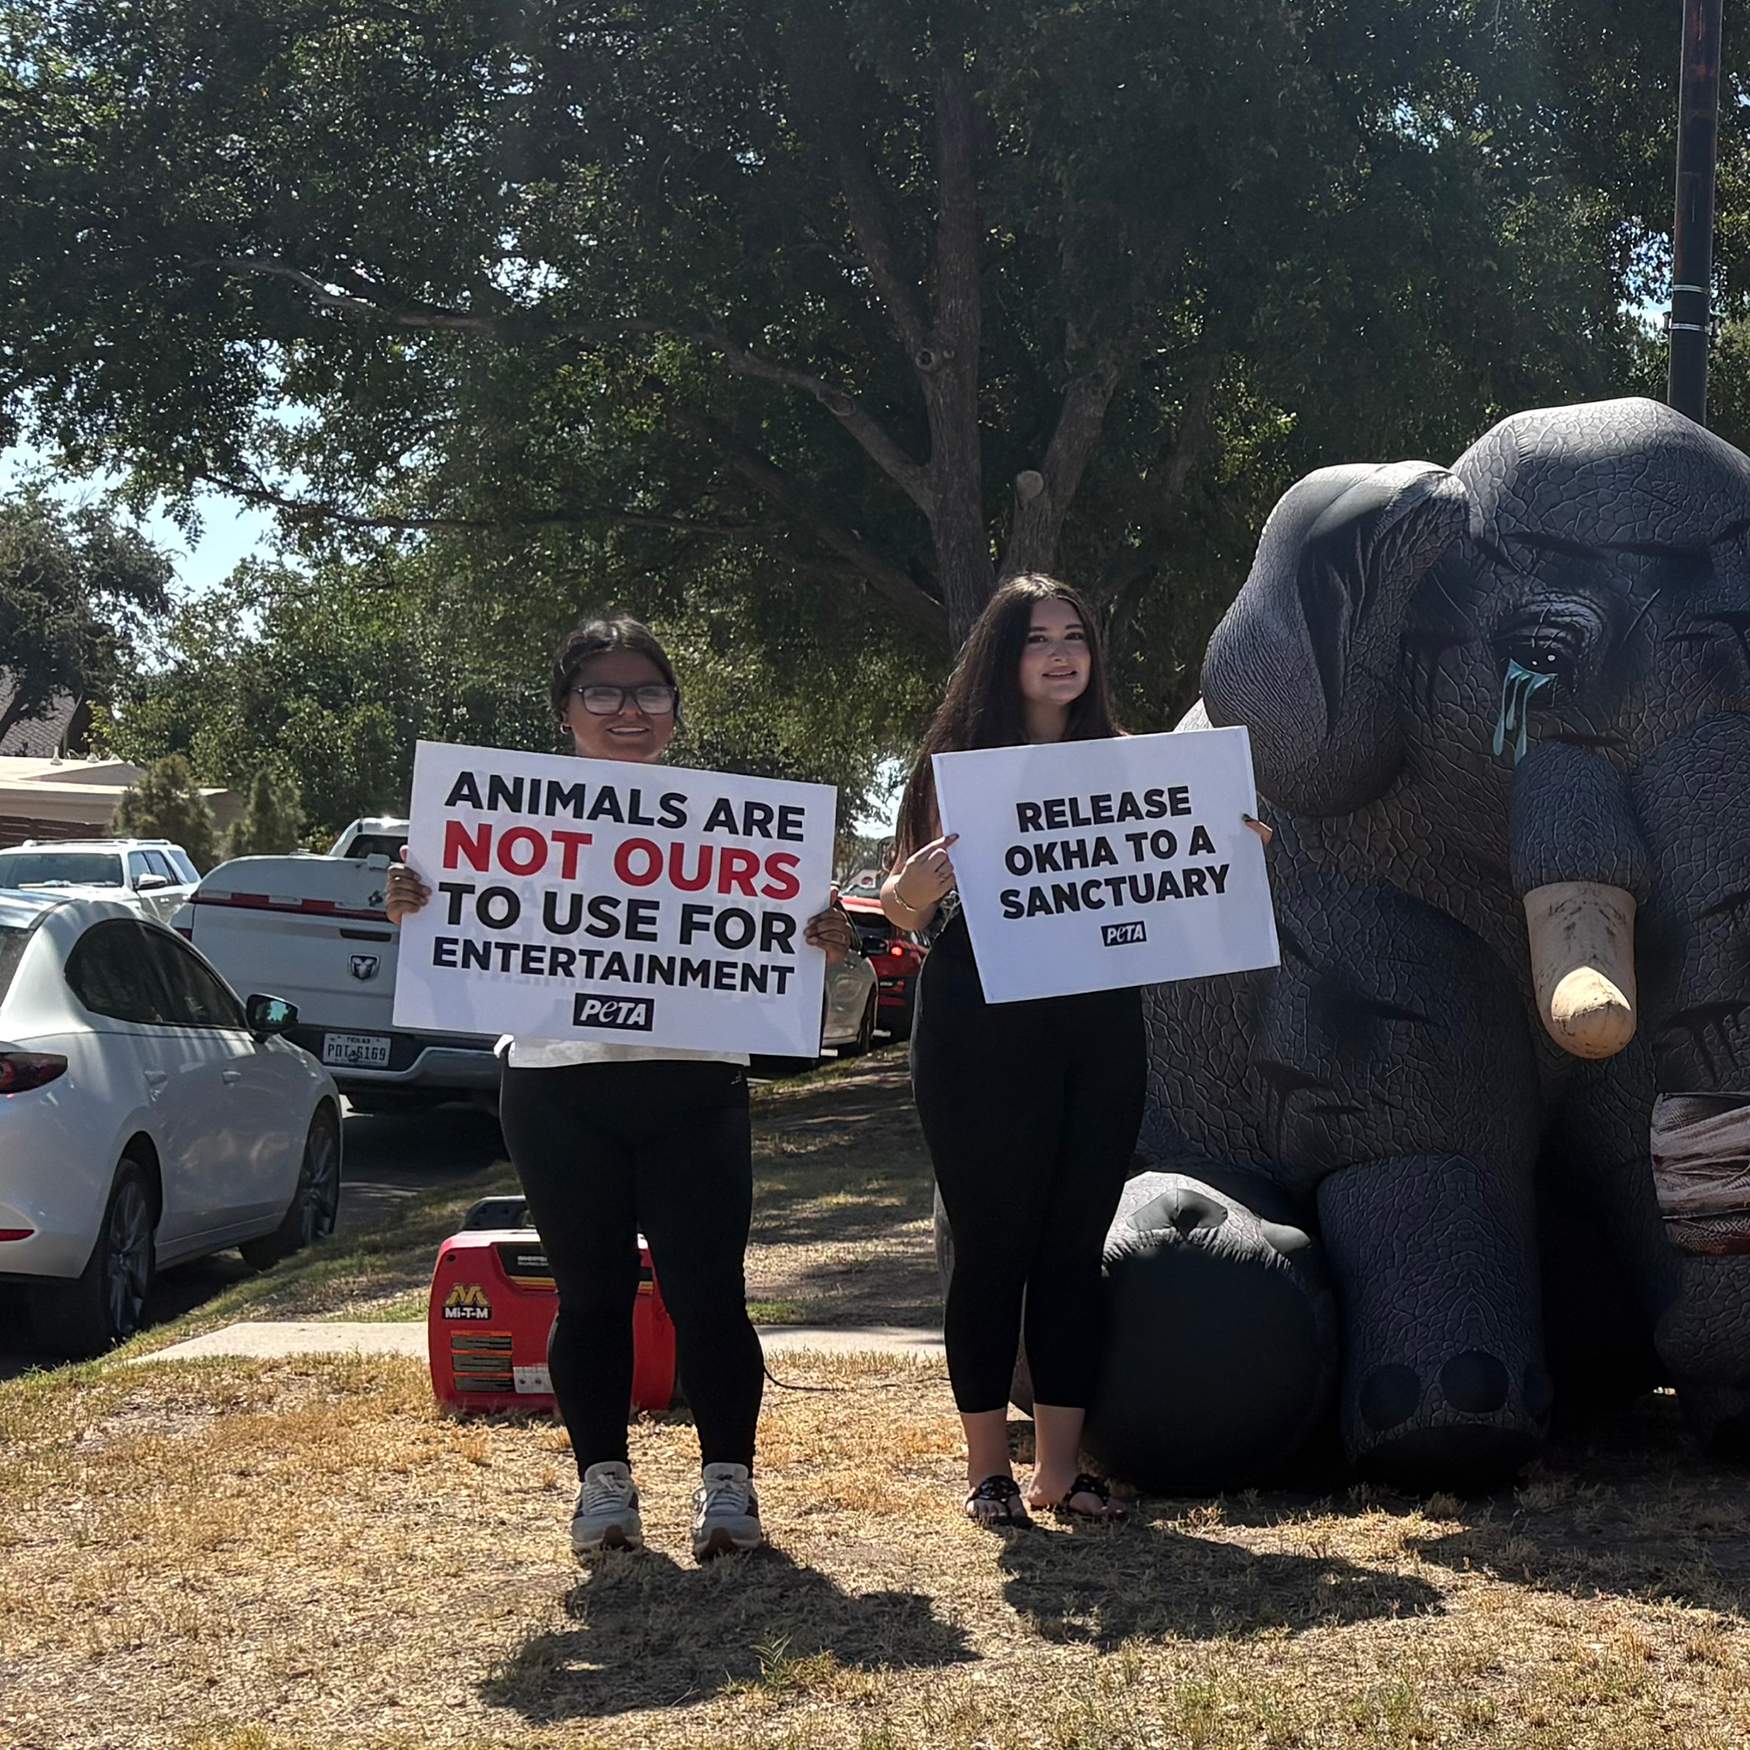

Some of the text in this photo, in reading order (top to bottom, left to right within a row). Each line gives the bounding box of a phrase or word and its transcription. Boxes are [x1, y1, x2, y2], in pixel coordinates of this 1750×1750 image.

[445, 771, 806, 843] ANIMALS ARE
[1016, 786, 1192, 832] RELEASE
[443, 821, 801, 900] NOT OURS
[1005, 826, 1216, 876] OKHA TO A
[1000, 864, 1230, 919] SANCTUARY
[438, 882, 797, 955] TO USE FOR
[1106, 923, 1144, 944] PeTA
[432, 937, 795, 995] ENTERTAINMENT
[579, 1000, 648, 1027] PeTA
[444, 1307, 489, 1319] Mi-T-M
